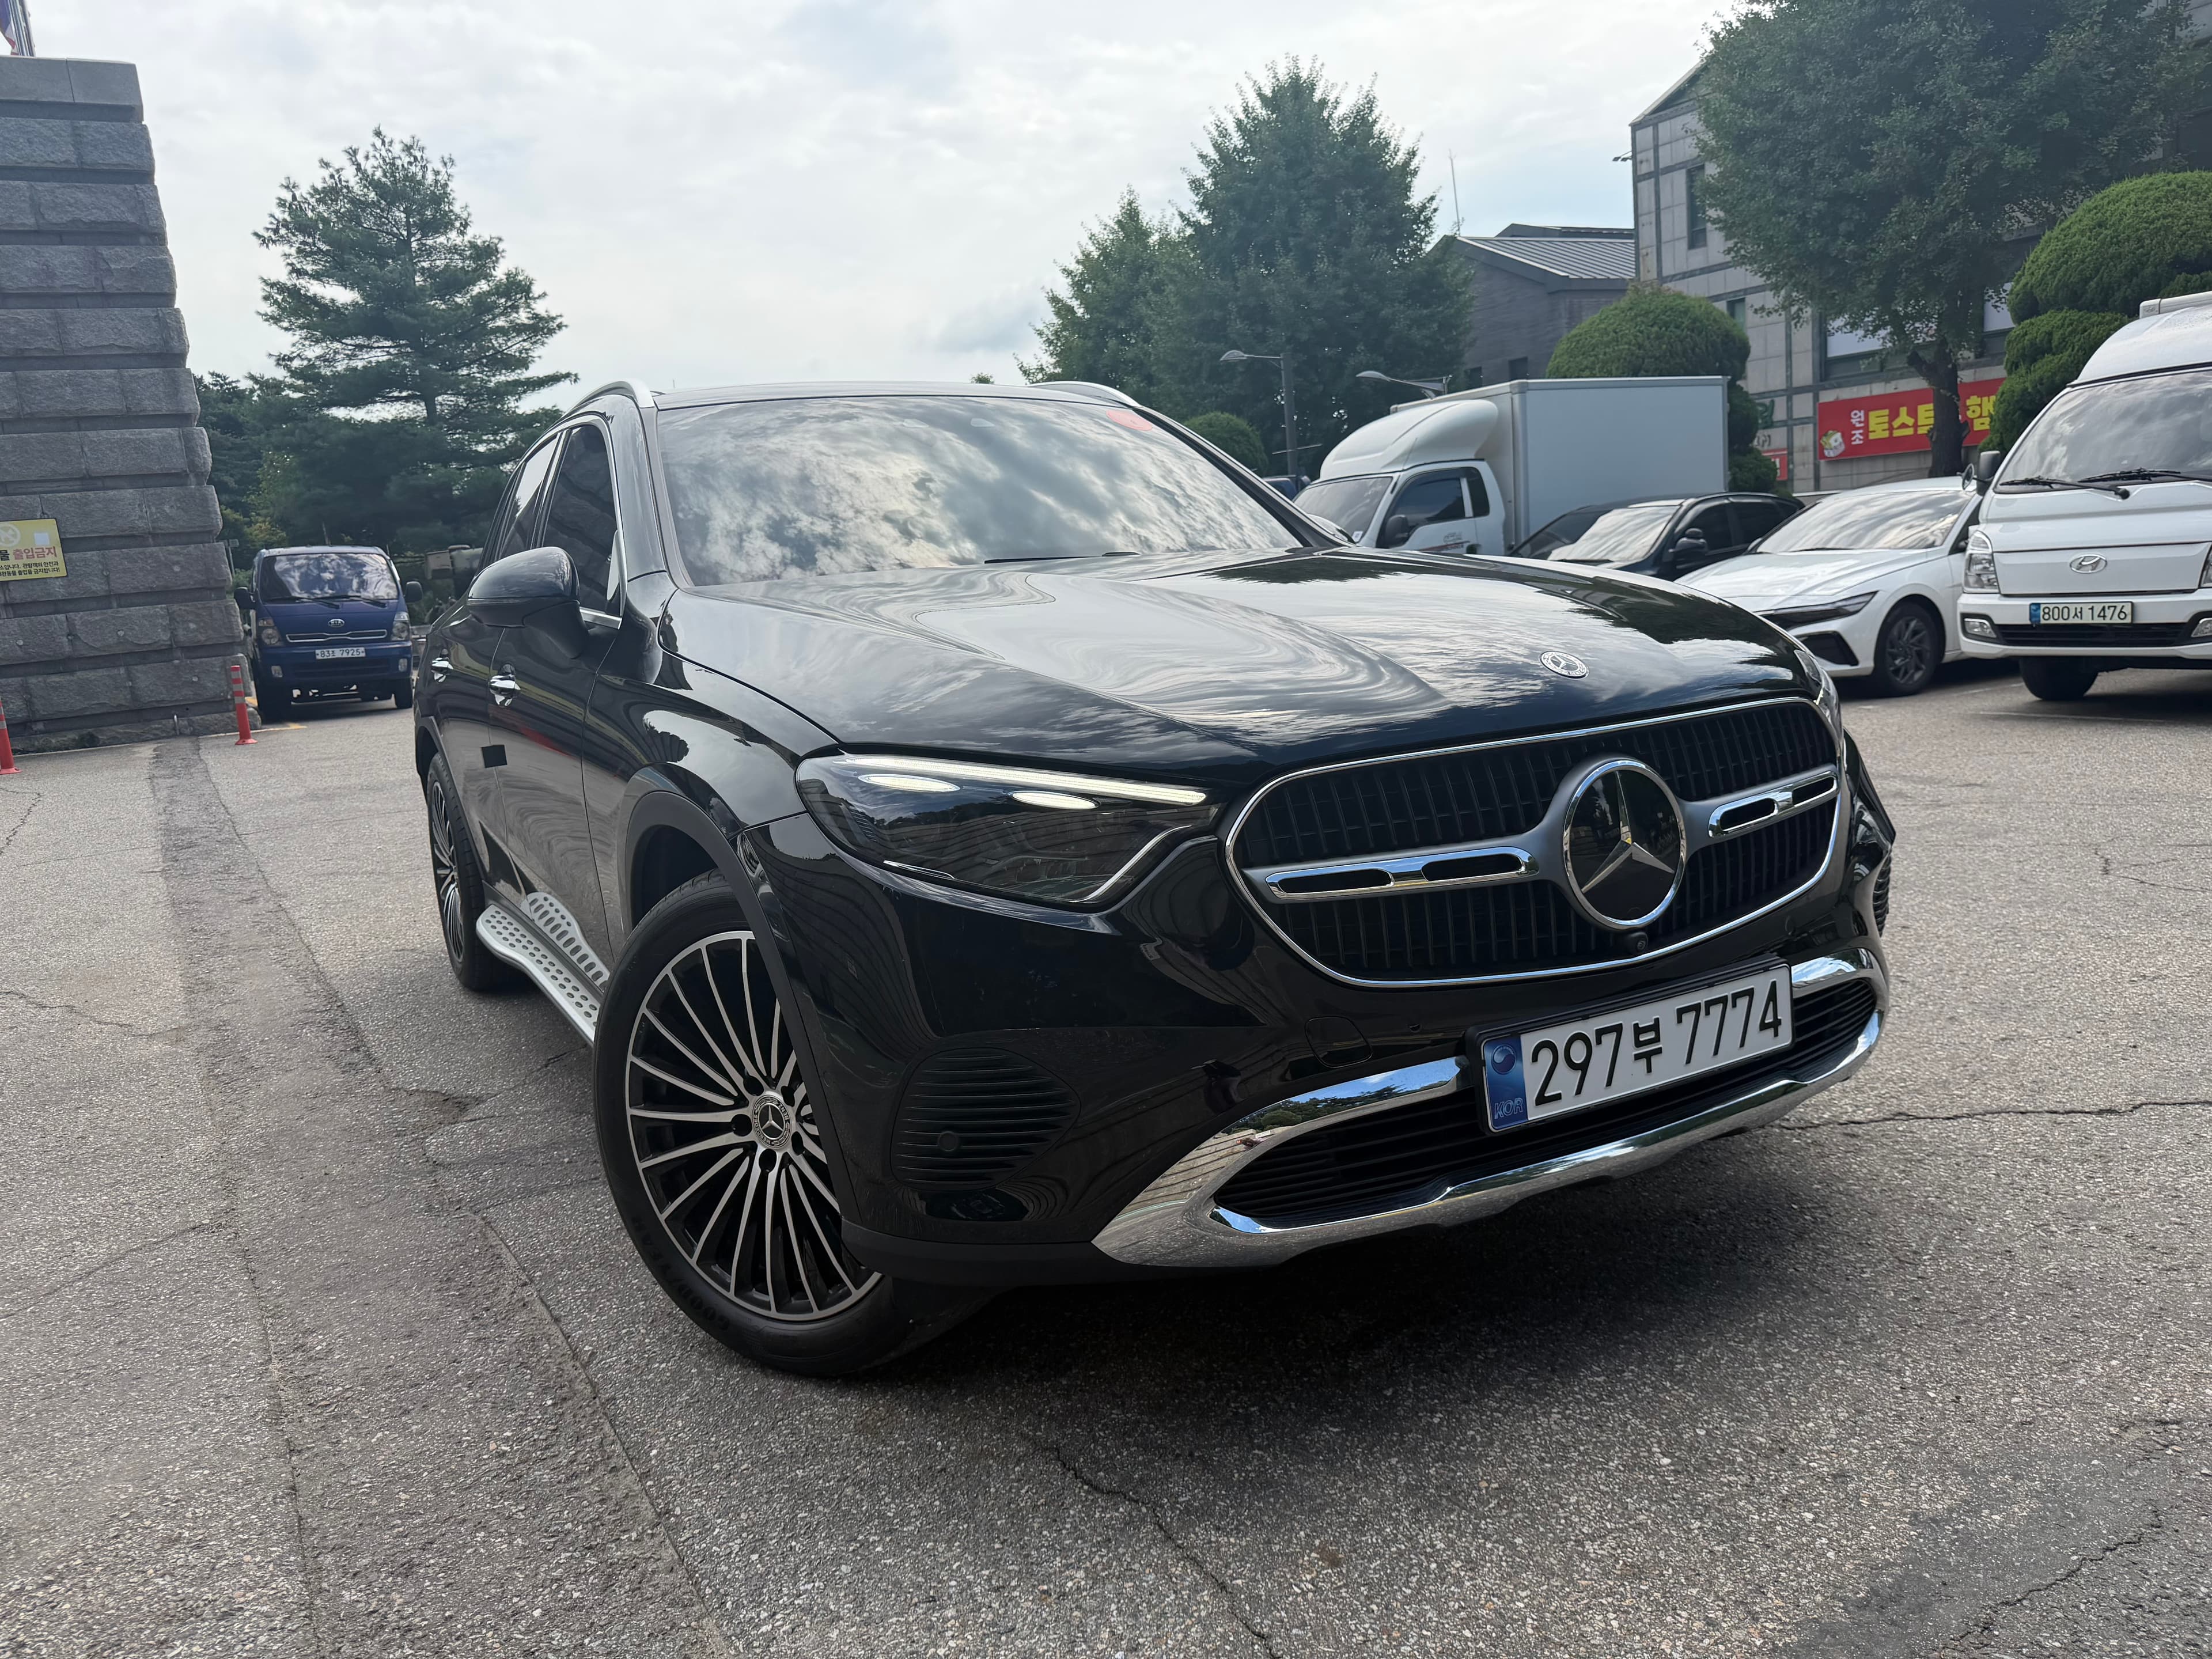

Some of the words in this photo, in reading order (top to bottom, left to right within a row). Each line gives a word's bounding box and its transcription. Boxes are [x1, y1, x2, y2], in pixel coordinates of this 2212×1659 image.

[1850, 410, 1864, 445] 원조
[1869, 403, 1934, 440] 토스트
[13, 546, 57, 560] 출입금지
[2042, 606, 2082, 621] 800서
[2088, 605, 2127, 620] 1476
[1530, 1017, 1663, 1107] 297부
[1676, 980, 1782, 1065] 7774
[1494, 1097, 1523, 1119] KOR
